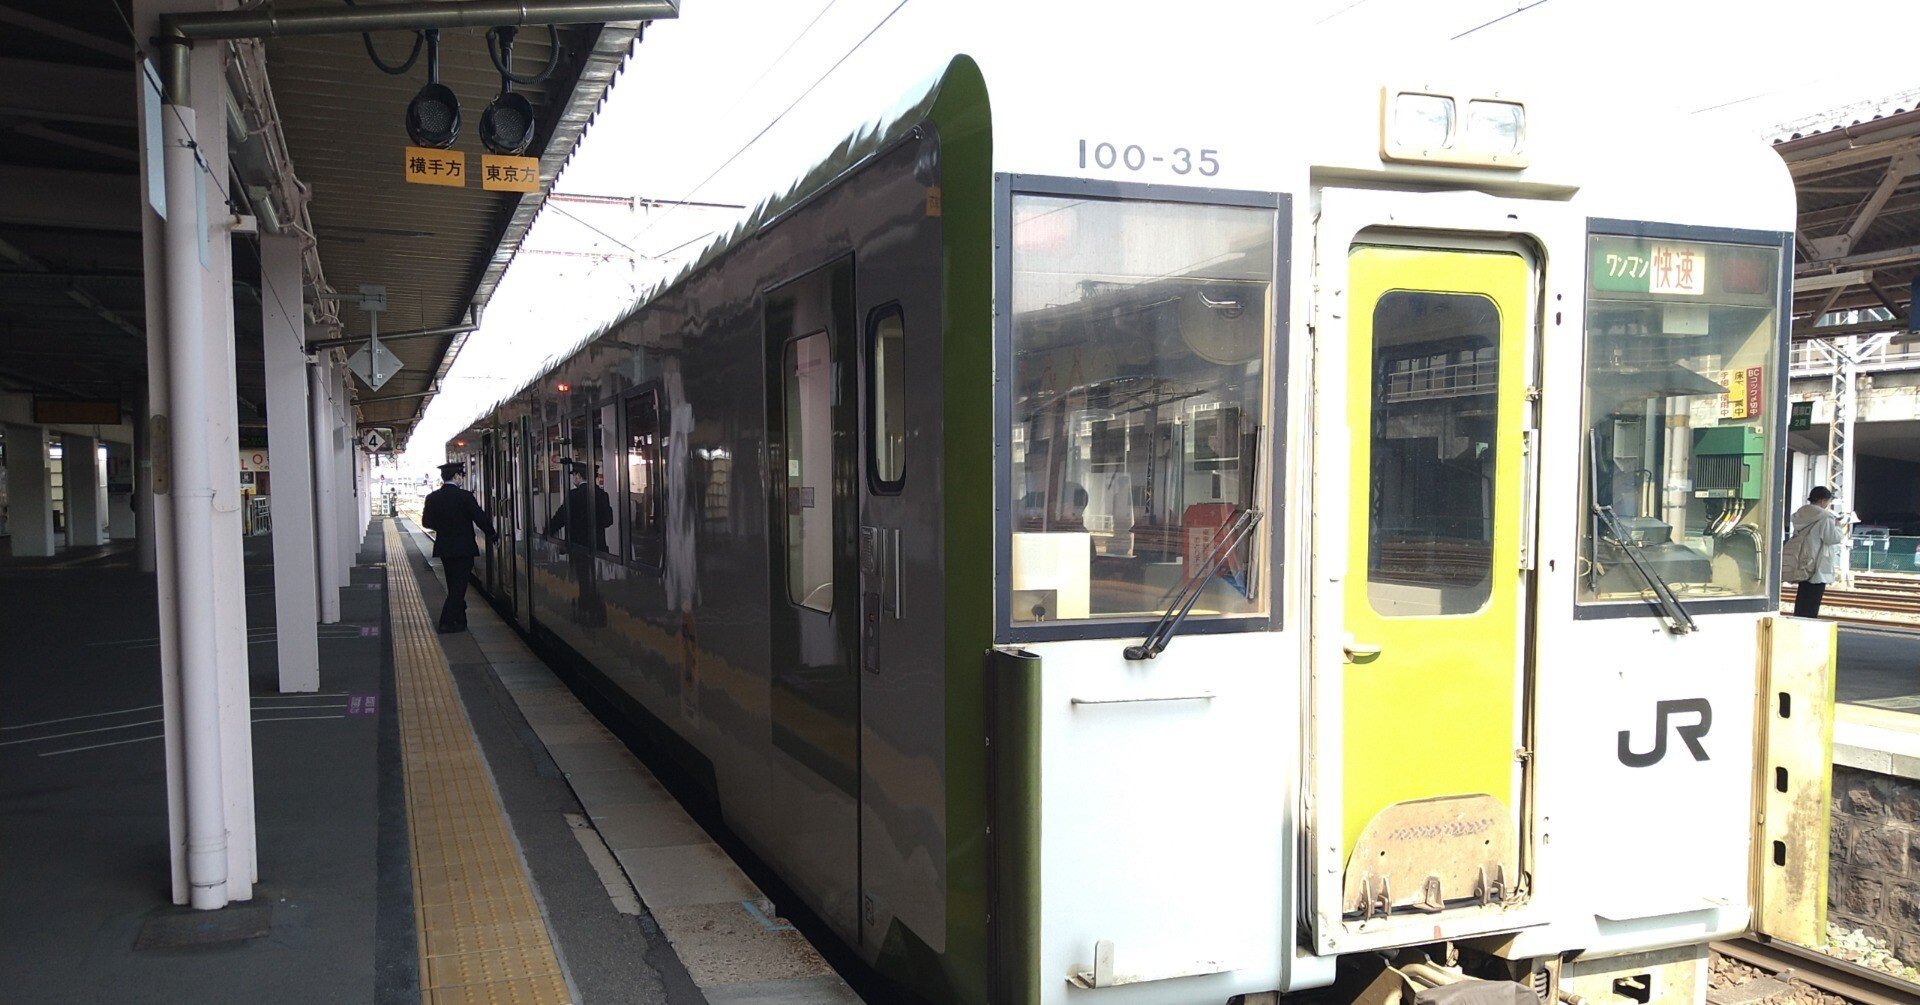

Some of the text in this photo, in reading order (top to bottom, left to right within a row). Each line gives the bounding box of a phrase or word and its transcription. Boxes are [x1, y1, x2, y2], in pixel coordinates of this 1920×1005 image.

[409, 156, 462, 177] 横手方
[1079, 139, 1220, 177] 100-35
[485, 165, 537, 183] 東京方
[1606, 246, 1696, 289] ワンマン 快速
[368, 434, 379, 448] 4
[1617, 697, 1713, 768] JR
